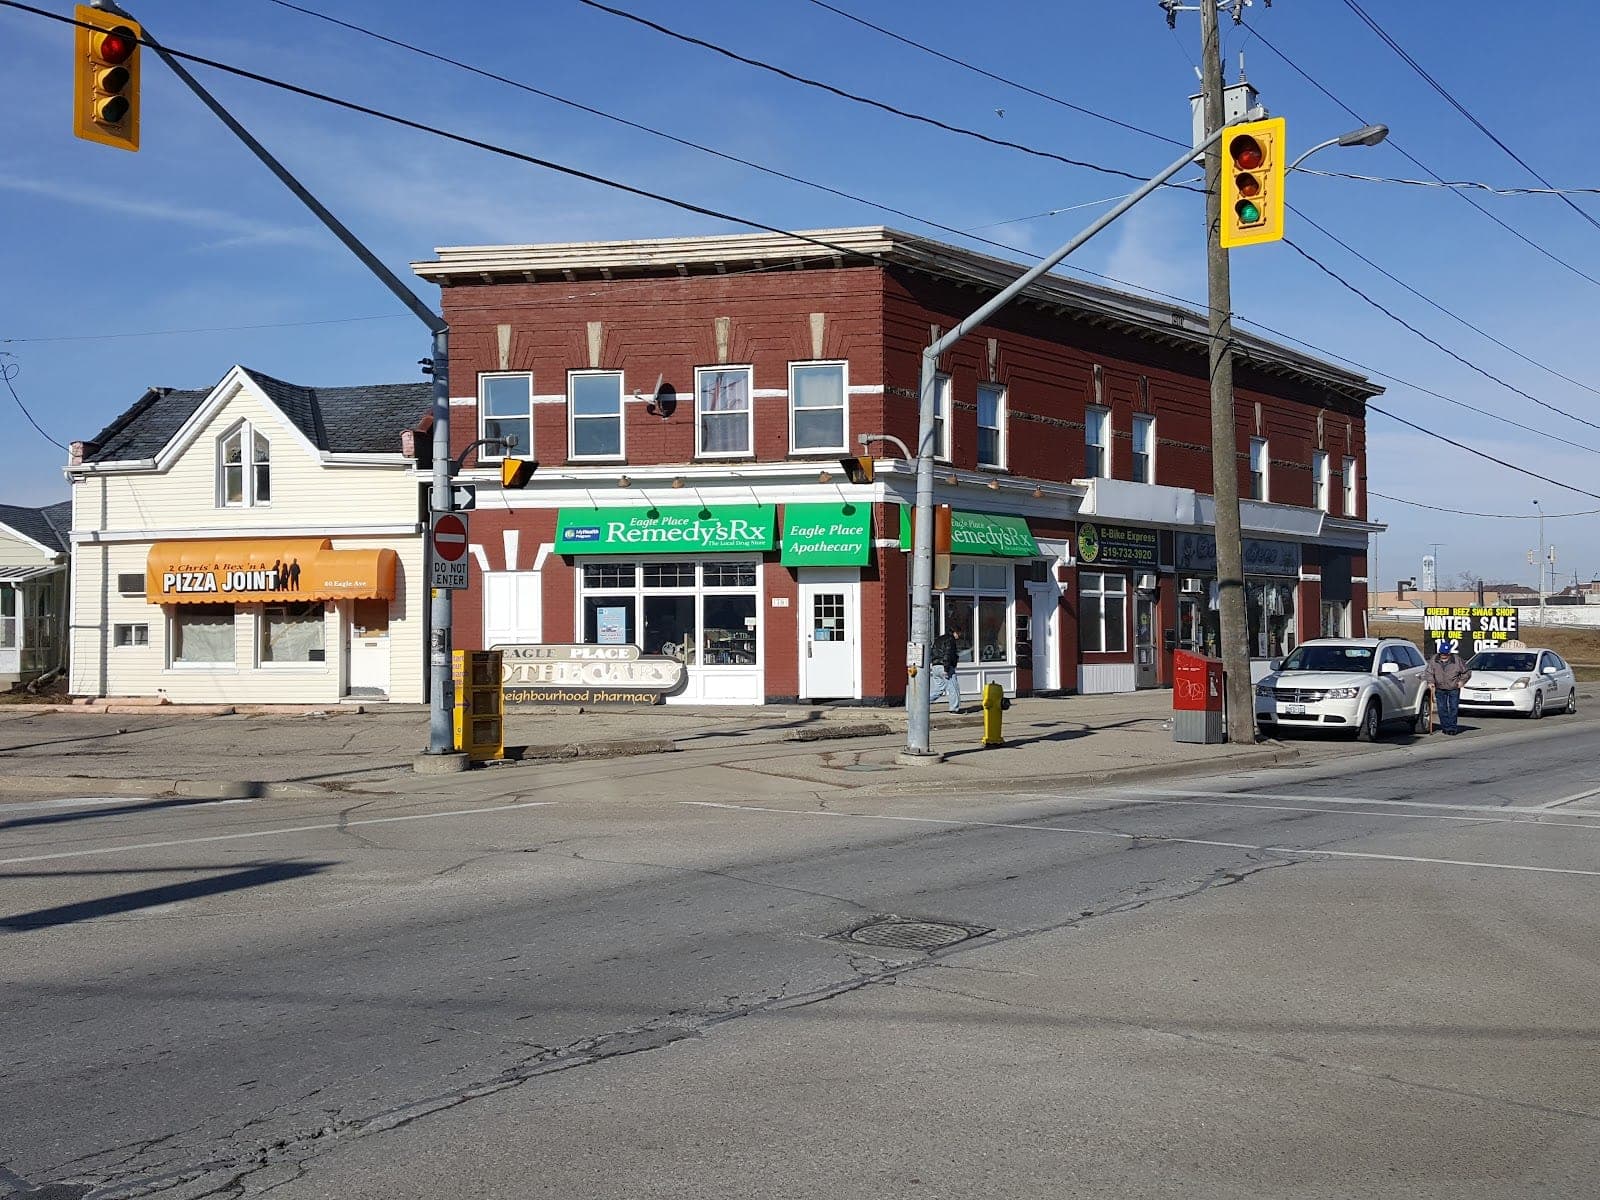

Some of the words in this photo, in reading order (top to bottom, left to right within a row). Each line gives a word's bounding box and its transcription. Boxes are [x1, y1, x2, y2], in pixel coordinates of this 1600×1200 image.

[630, 517, 659, 529] Eagle
[661, 516, 690, 526] Place
[790, 525, 826, 539] Eagle
[829, 524, 863, 535] Place
[951, 526, 1032, 550] emedy'sRx
[1126, 531, 1156, 543] Express
[789, 541, 863, 555] Apothecary
[434, 562, 447, 573] DO
[450, 563, 466, 574] NOT
[163, 571, 219, 594] PIZZA
[221, 570, 278, 592] JOINT
[436, 574, 464, 585] ENTER
[1426, 607, 1450, 616] QUEEN
[1495, 608, 1516, 617] SHOP
[1424, 615, 1471, 631] WINTER
[1479, 616, 1517, 632] SALE
[1431, 630, 1446, 639] BUY
[1447, 631, 1463, 640] ONE
[1472, 631, 1486, 640] GET
[1491, 631, 1508, 640] ONE
[570, 648, 629, 660] PLACE
[503, 690, 590, 704] eighbourhood
[593, 691, 657, 704] pharmacy
